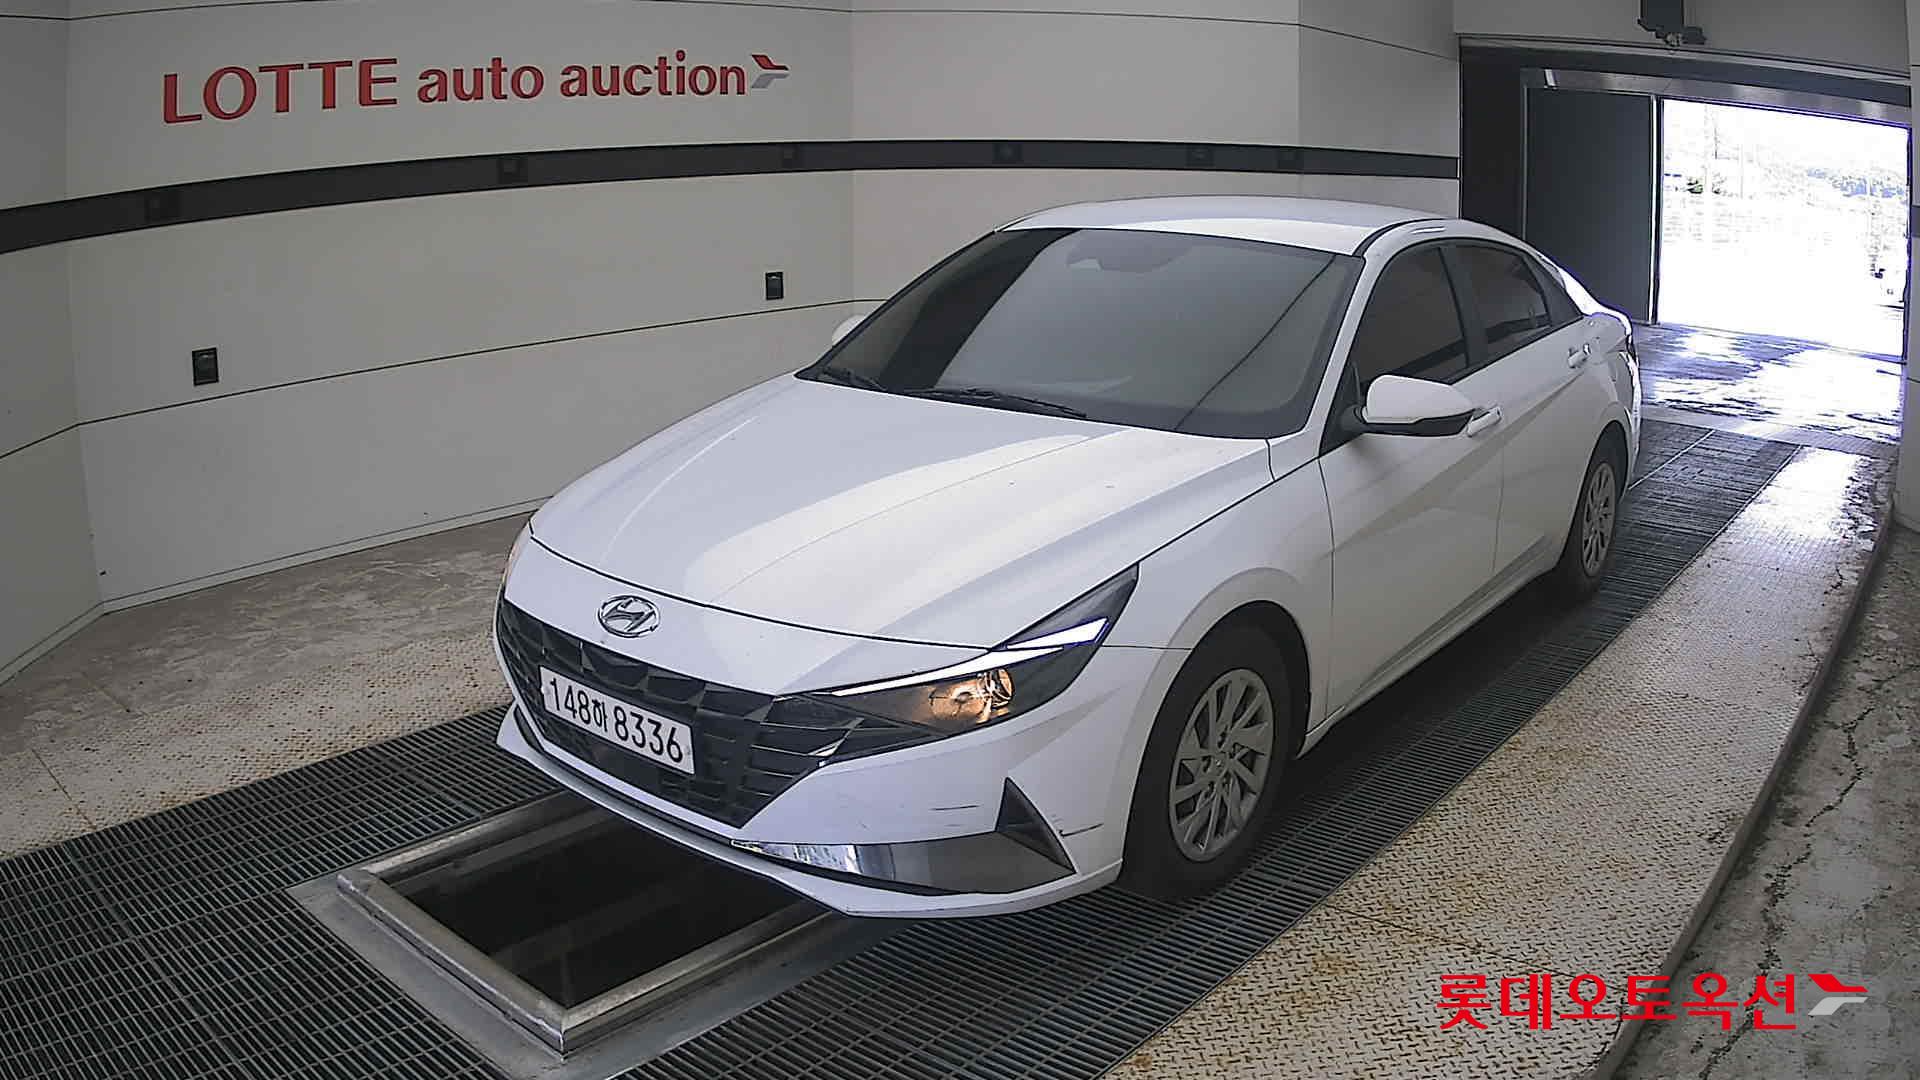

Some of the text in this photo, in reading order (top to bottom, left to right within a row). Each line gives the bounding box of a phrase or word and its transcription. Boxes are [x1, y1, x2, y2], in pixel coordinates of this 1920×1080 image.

[163, 50, 746, 124] LOTTE auto auction
[614, 706, 684, 763] 8336
